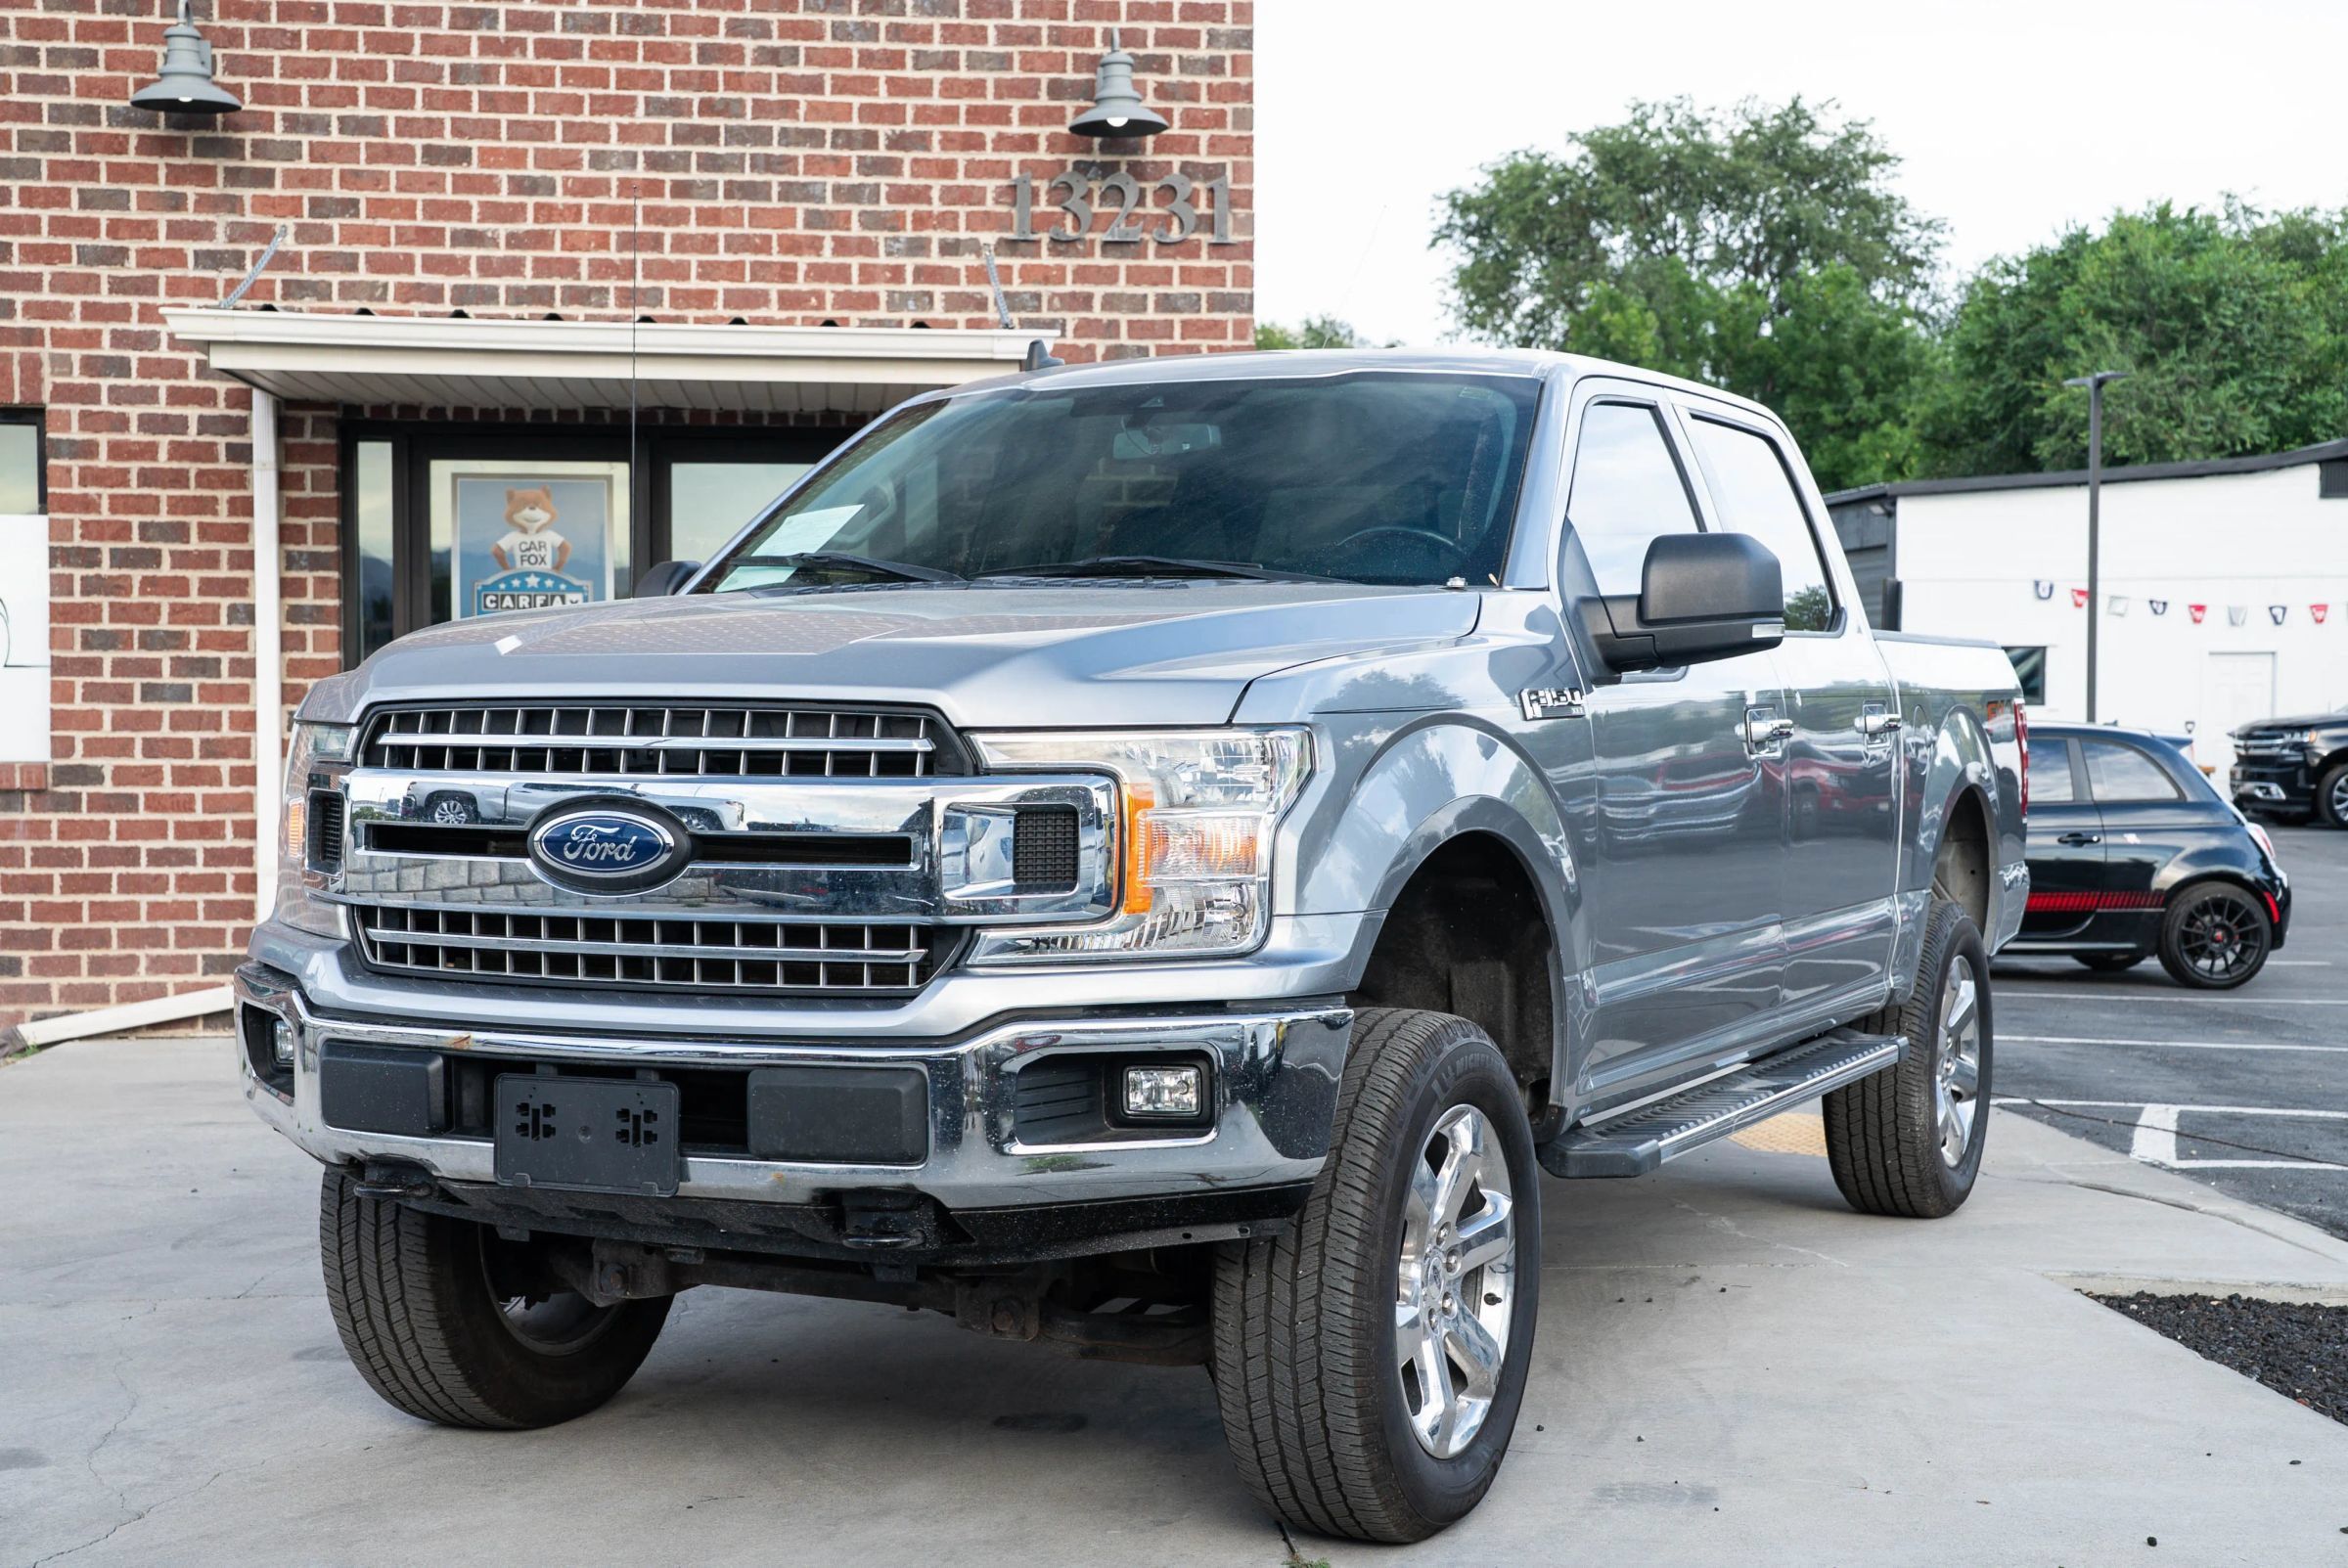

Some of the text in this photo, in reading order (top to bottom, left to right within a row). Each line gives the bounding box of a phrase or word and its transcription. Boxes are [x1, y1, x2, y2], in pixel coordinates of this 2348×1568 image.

[1010, 171, 1238, 245] 13231
[519, 540, 548, 553] CAR
[519, 554, 548, 566] FOX
[563, 824, 639, 862] Ford
